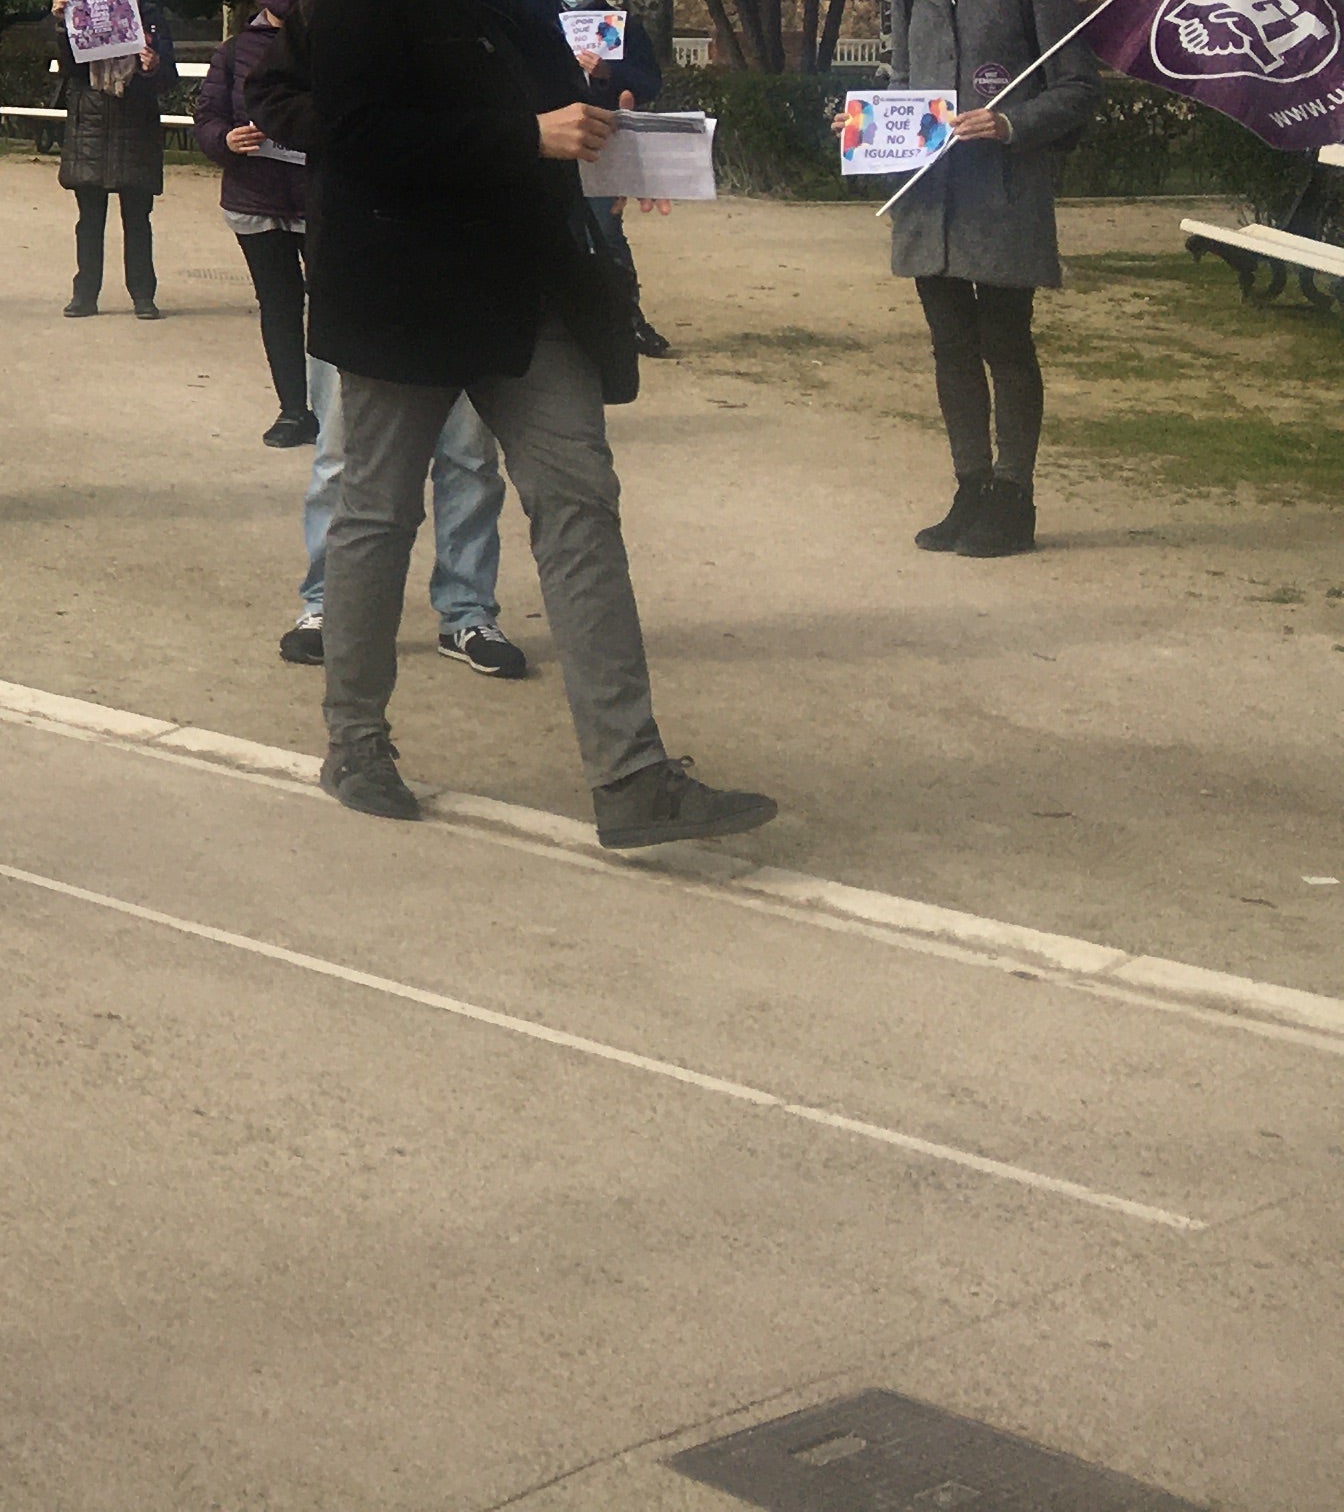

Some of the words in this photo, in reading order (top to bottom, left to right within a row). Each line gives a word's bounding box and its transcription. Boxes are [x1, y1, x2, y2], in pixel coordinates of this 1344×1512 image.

[883, 106, 914, 117] ¿POR
[885, 119, 910, 131] QUÉ
[887, 135, 905, 144] NO
[864, 149, 922, 159] IGUALES?
